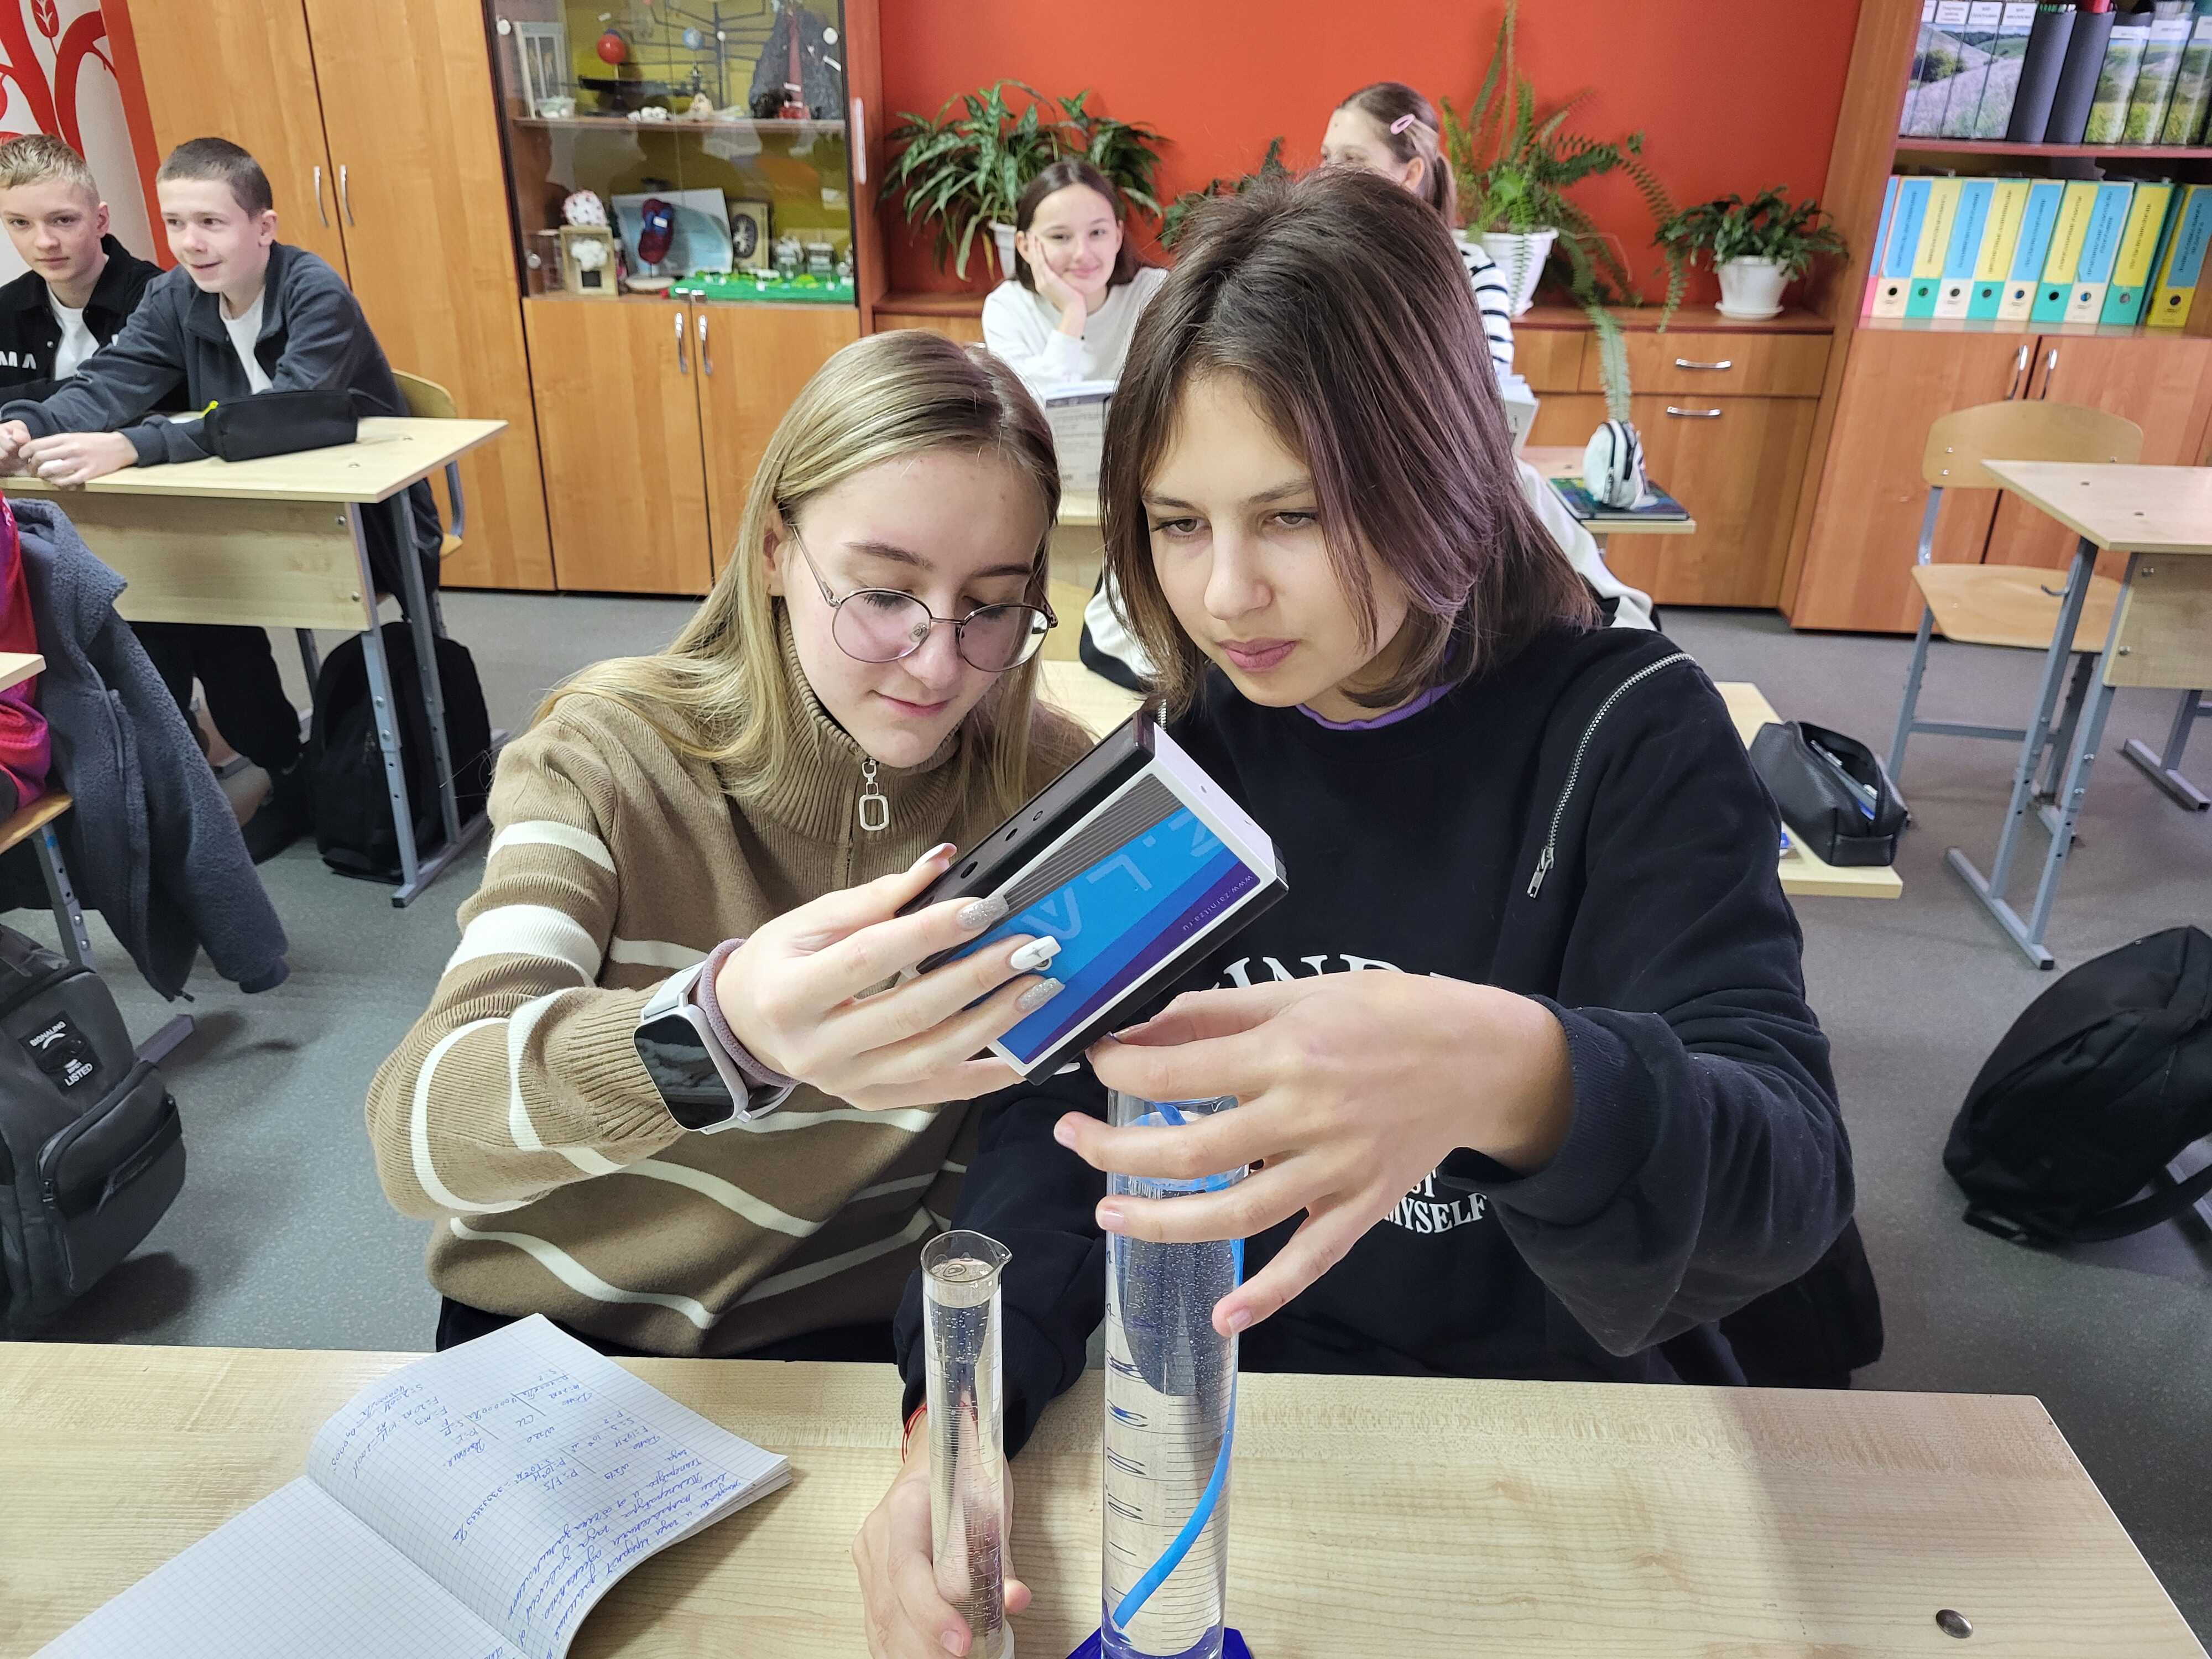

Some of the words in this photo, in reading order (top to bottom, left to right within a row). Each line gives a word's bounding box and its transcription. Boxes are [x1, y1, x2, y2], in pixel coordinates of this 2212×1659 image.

[1019, 807, 1222, 939] Z.LA
[1182, 874, 1254, 931] www.zarnitza.ru
[29, 1021, 66, 1047] SIGNALING
[64, 1063, 93, 1087] LISTED
